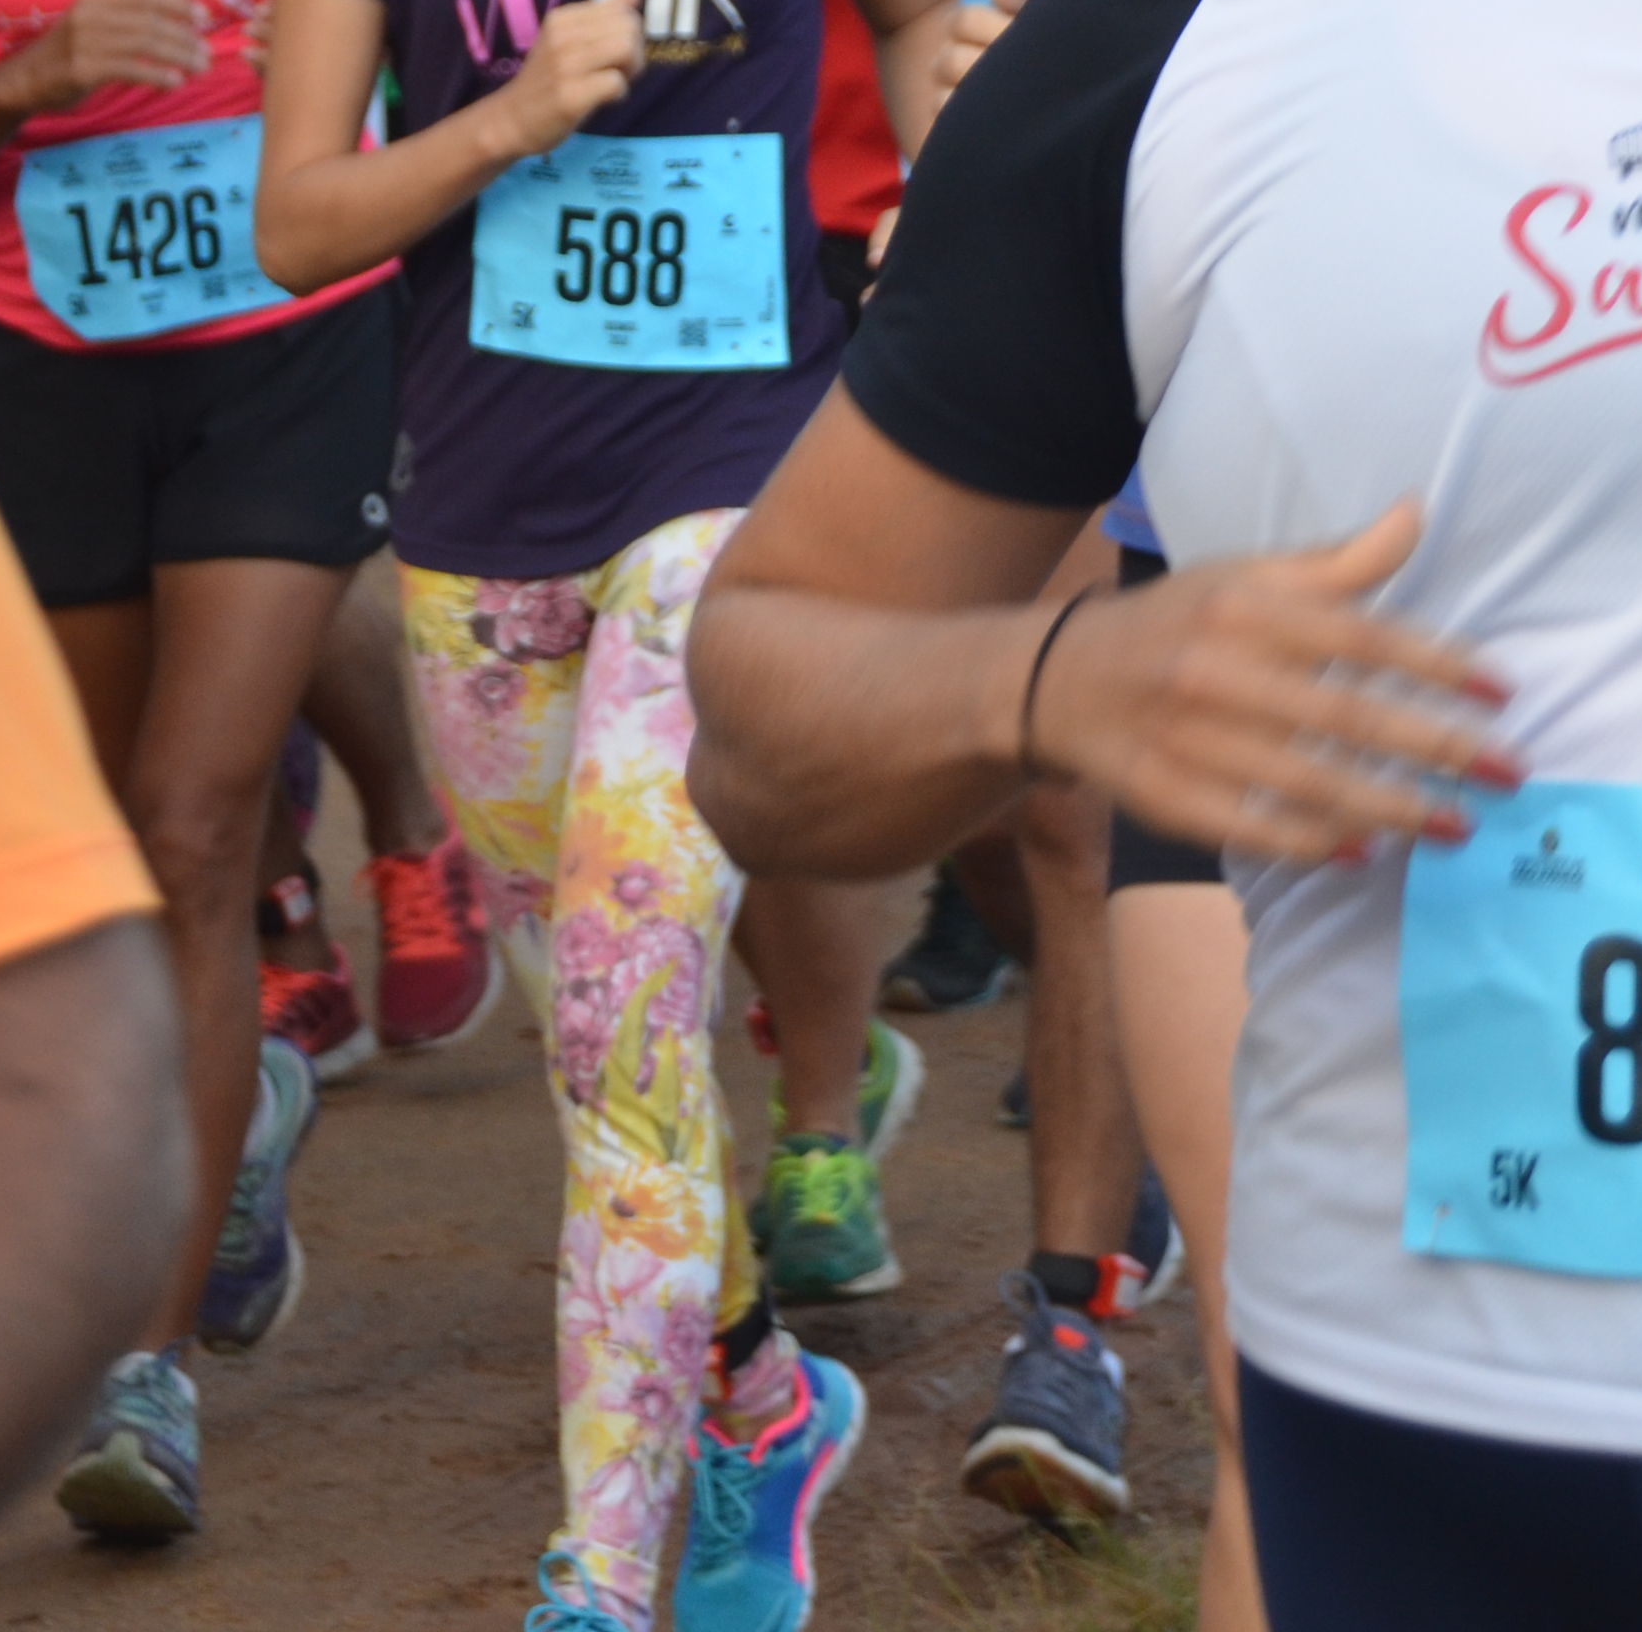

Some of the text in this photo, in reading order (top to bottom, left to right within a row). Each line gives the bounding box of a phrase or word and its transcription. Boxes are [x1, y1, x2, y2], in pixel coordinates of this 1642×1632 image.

[66, 188, 221, 286] 1426
[556, 204, 686, 307] 588
[1489, 1150, 1539, 1211] 5K
